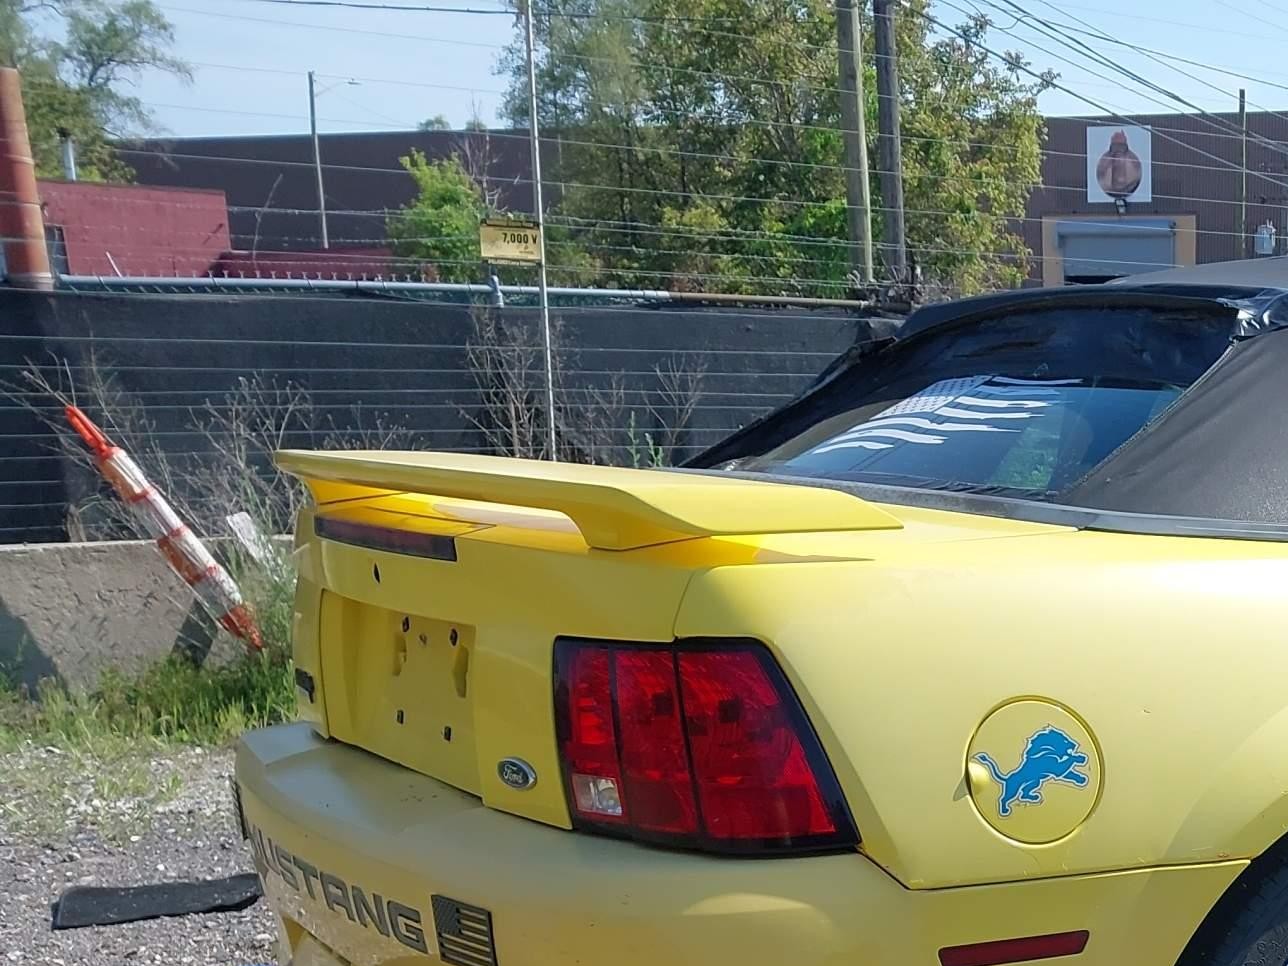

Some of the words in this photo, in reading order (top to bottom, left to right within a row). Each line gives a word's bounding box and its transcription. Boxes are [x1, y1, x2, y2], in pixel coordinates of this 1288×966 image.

[501, 231, 529, 245] 7,000
[531, 233, 538, 245] V
[503, 763, 524, 784] Ford
